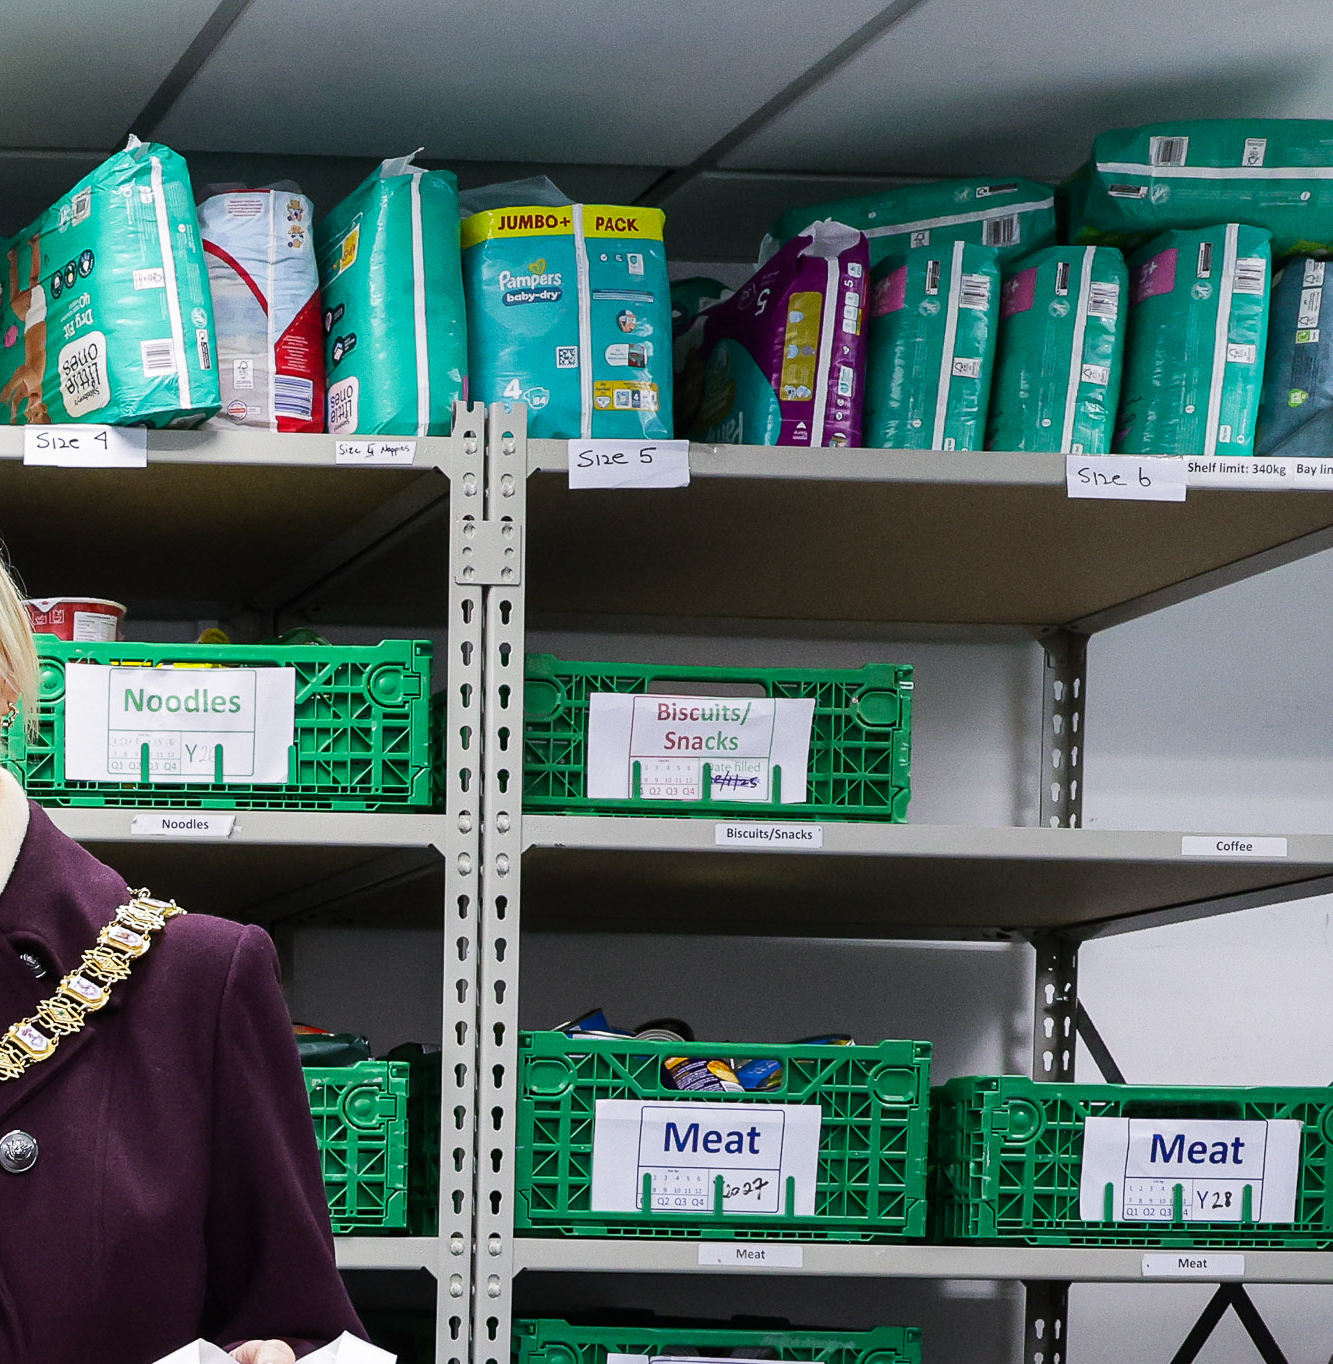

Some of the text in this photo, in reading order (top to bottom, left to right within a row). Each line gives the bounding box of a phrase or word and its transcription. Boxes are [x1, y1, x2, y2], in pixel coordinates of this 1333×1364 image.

[498, 216, 639, 232] JUMBO+ PACK
[499, 271, 562, 289] Pampers
[639, 447, 657, 464] 5
[1139, 467, 1151, 487] 6
[1188, 463, 1286, 476] Shelf limit: 340kg
[124, 689, 241, 713] Noodles
[657, 702, 751, 726] Biscuits/
[664, 731, 738, 750] Snacks
[162, 819, 209, 829] Noodles
[727, 828, 813, 839] Biscuits/Snacks
[1216, 840, 1253, 852] Coffee
[664, 1122, 760, 1154] Meat
[1150, 1134, 1244, 1164] Meat
[736, 1249, 765, 1259] Meat
[1178, 1259, 1207, 1268] Meat
